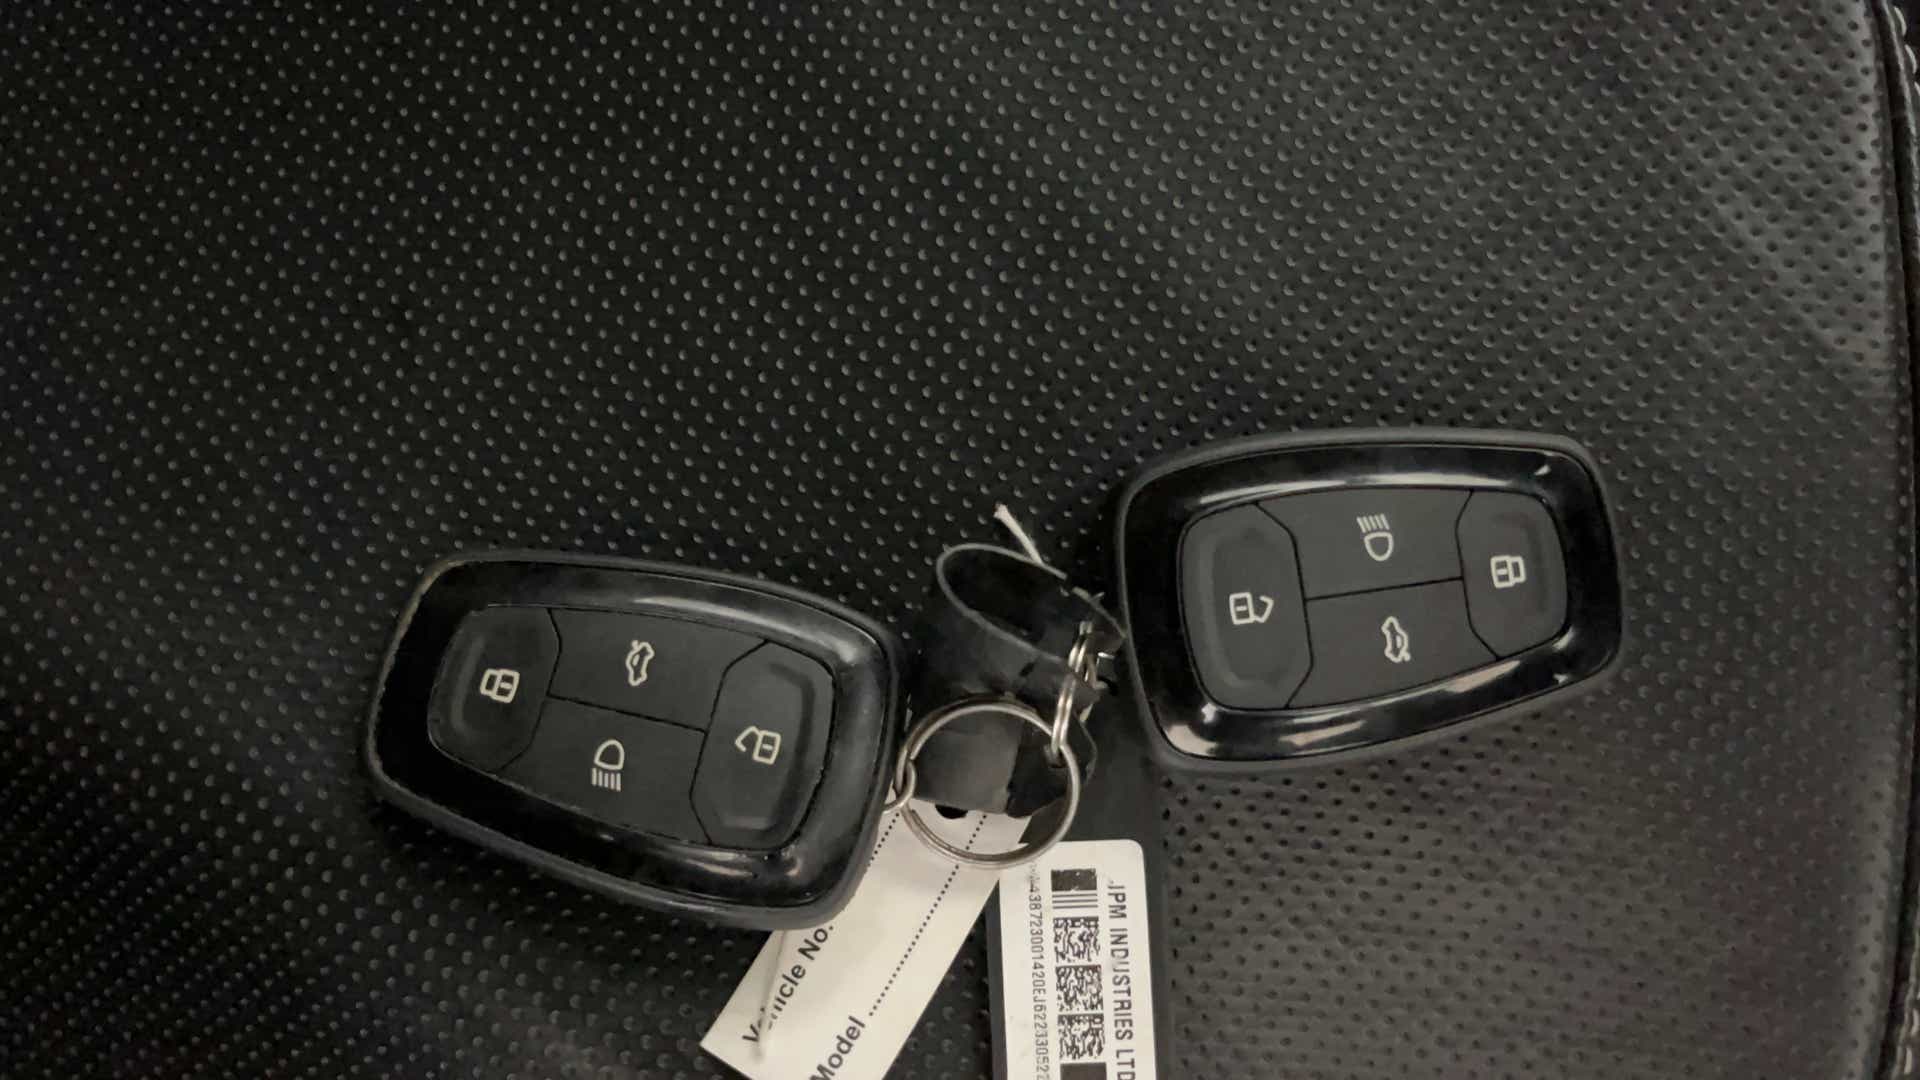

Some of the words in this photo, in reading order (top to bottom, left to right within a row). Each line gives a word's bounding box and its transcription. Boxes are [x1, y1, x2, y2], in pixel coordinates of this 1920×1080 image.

[798, 925, 834, 961] No.
[1110, 928, 1133, 1041] INDUSTRIES
[809, 1015, 866, 1080] Model
